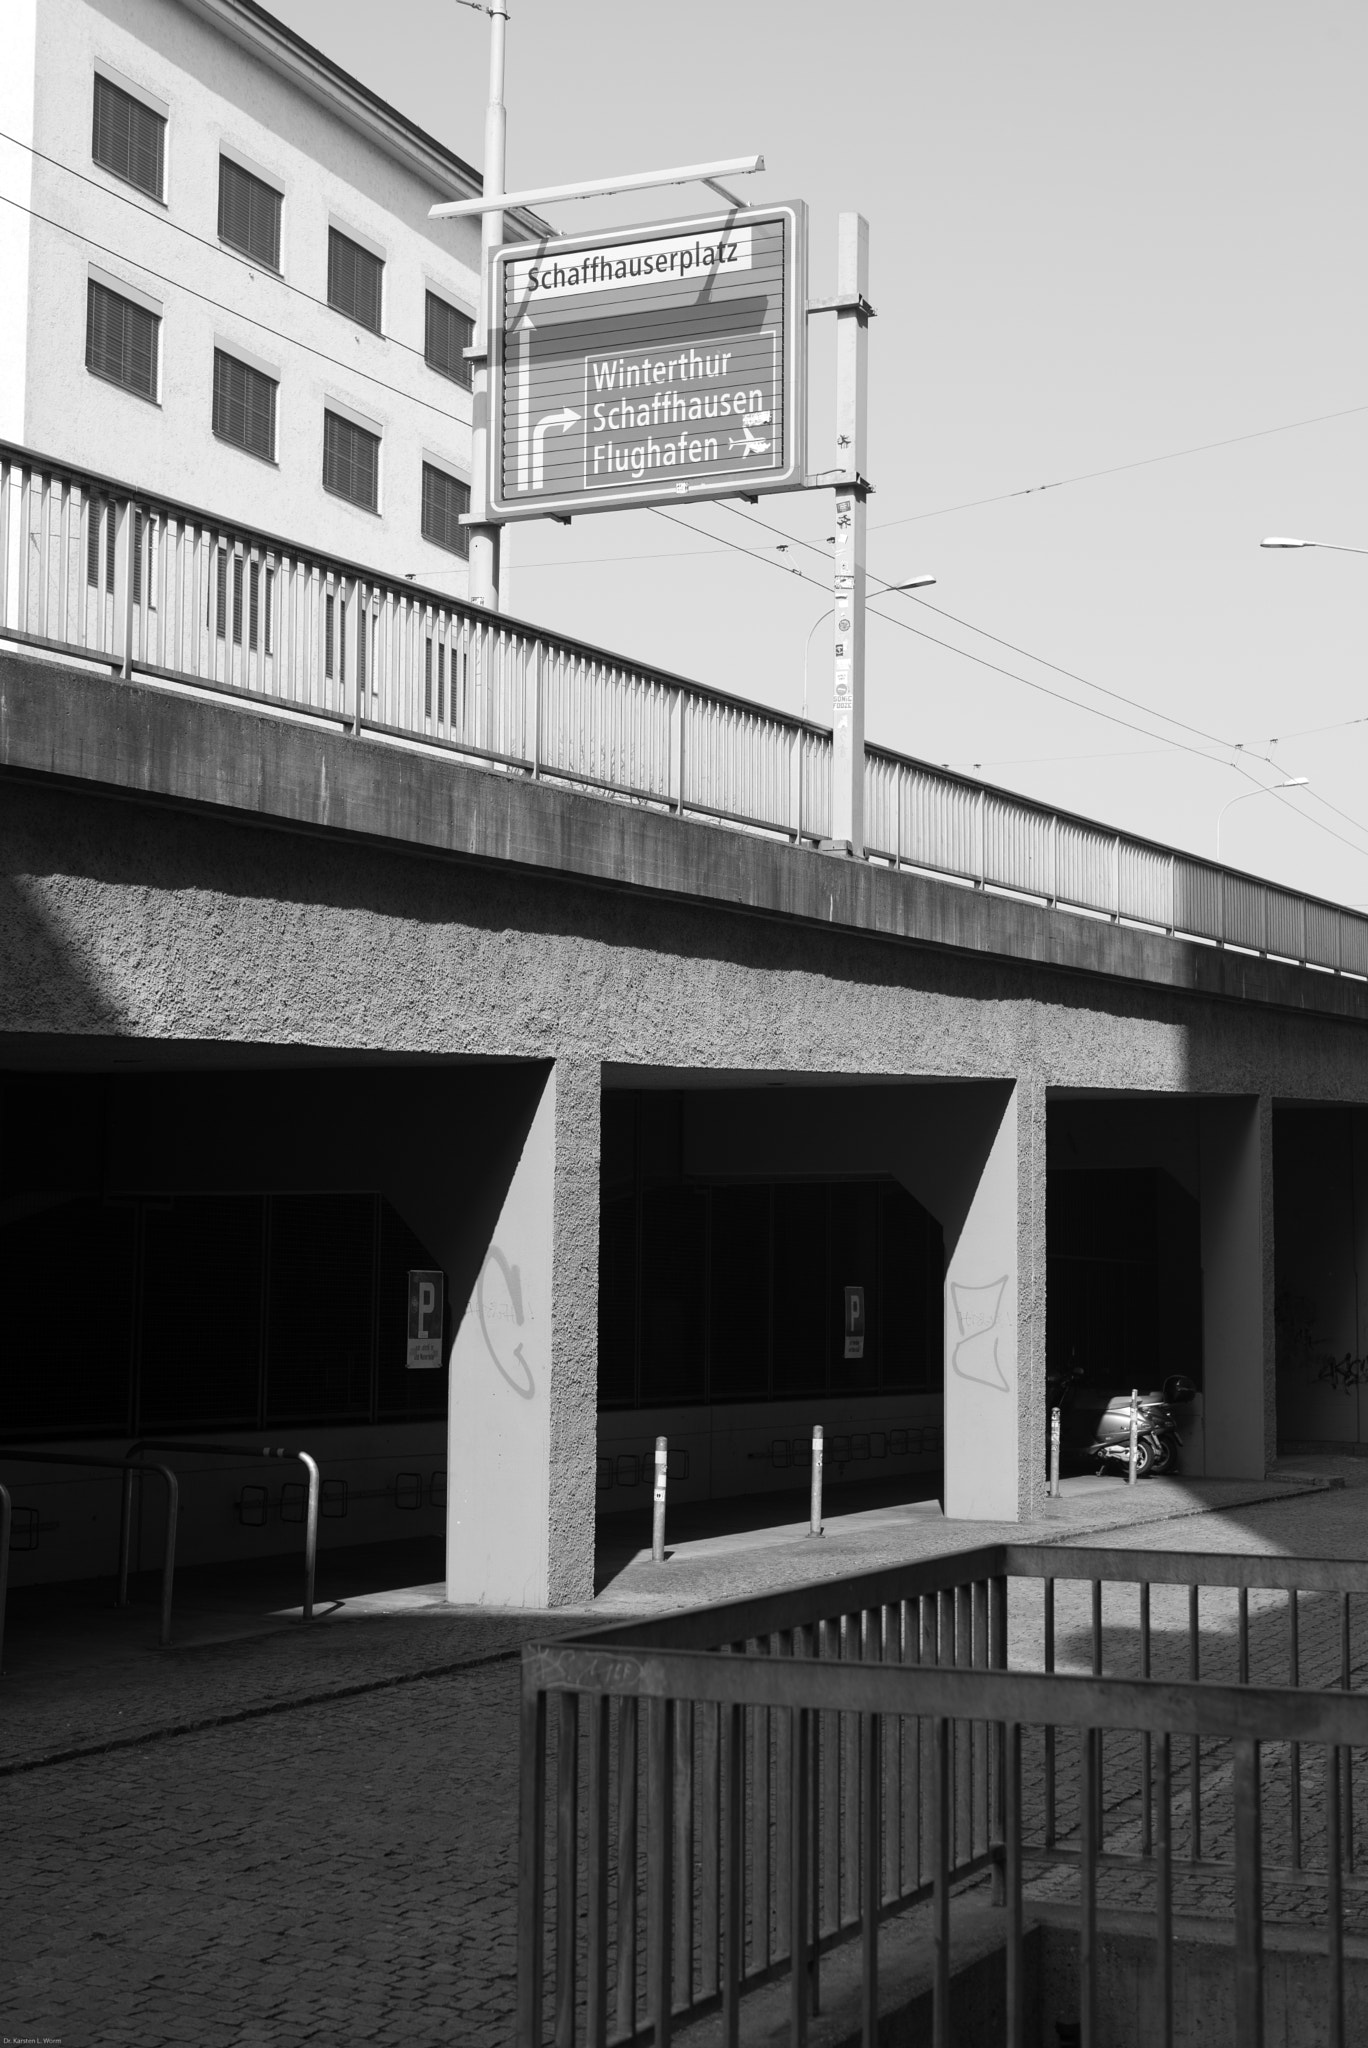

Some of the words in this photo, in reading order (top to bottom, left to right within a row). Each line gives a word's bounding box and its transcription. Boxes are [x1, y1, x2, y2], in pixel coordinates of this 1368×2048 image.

[529, 241, 738, 291] Schaffhauserplatz
[593, 349, 732, 392] Winterthur
[593, 389, 763, 432] Schaffhausen
[593, 432, 718, 478] Flughafen
[418, 1282, 435, 1338] P
[850, 1295, 860, 1332] P
